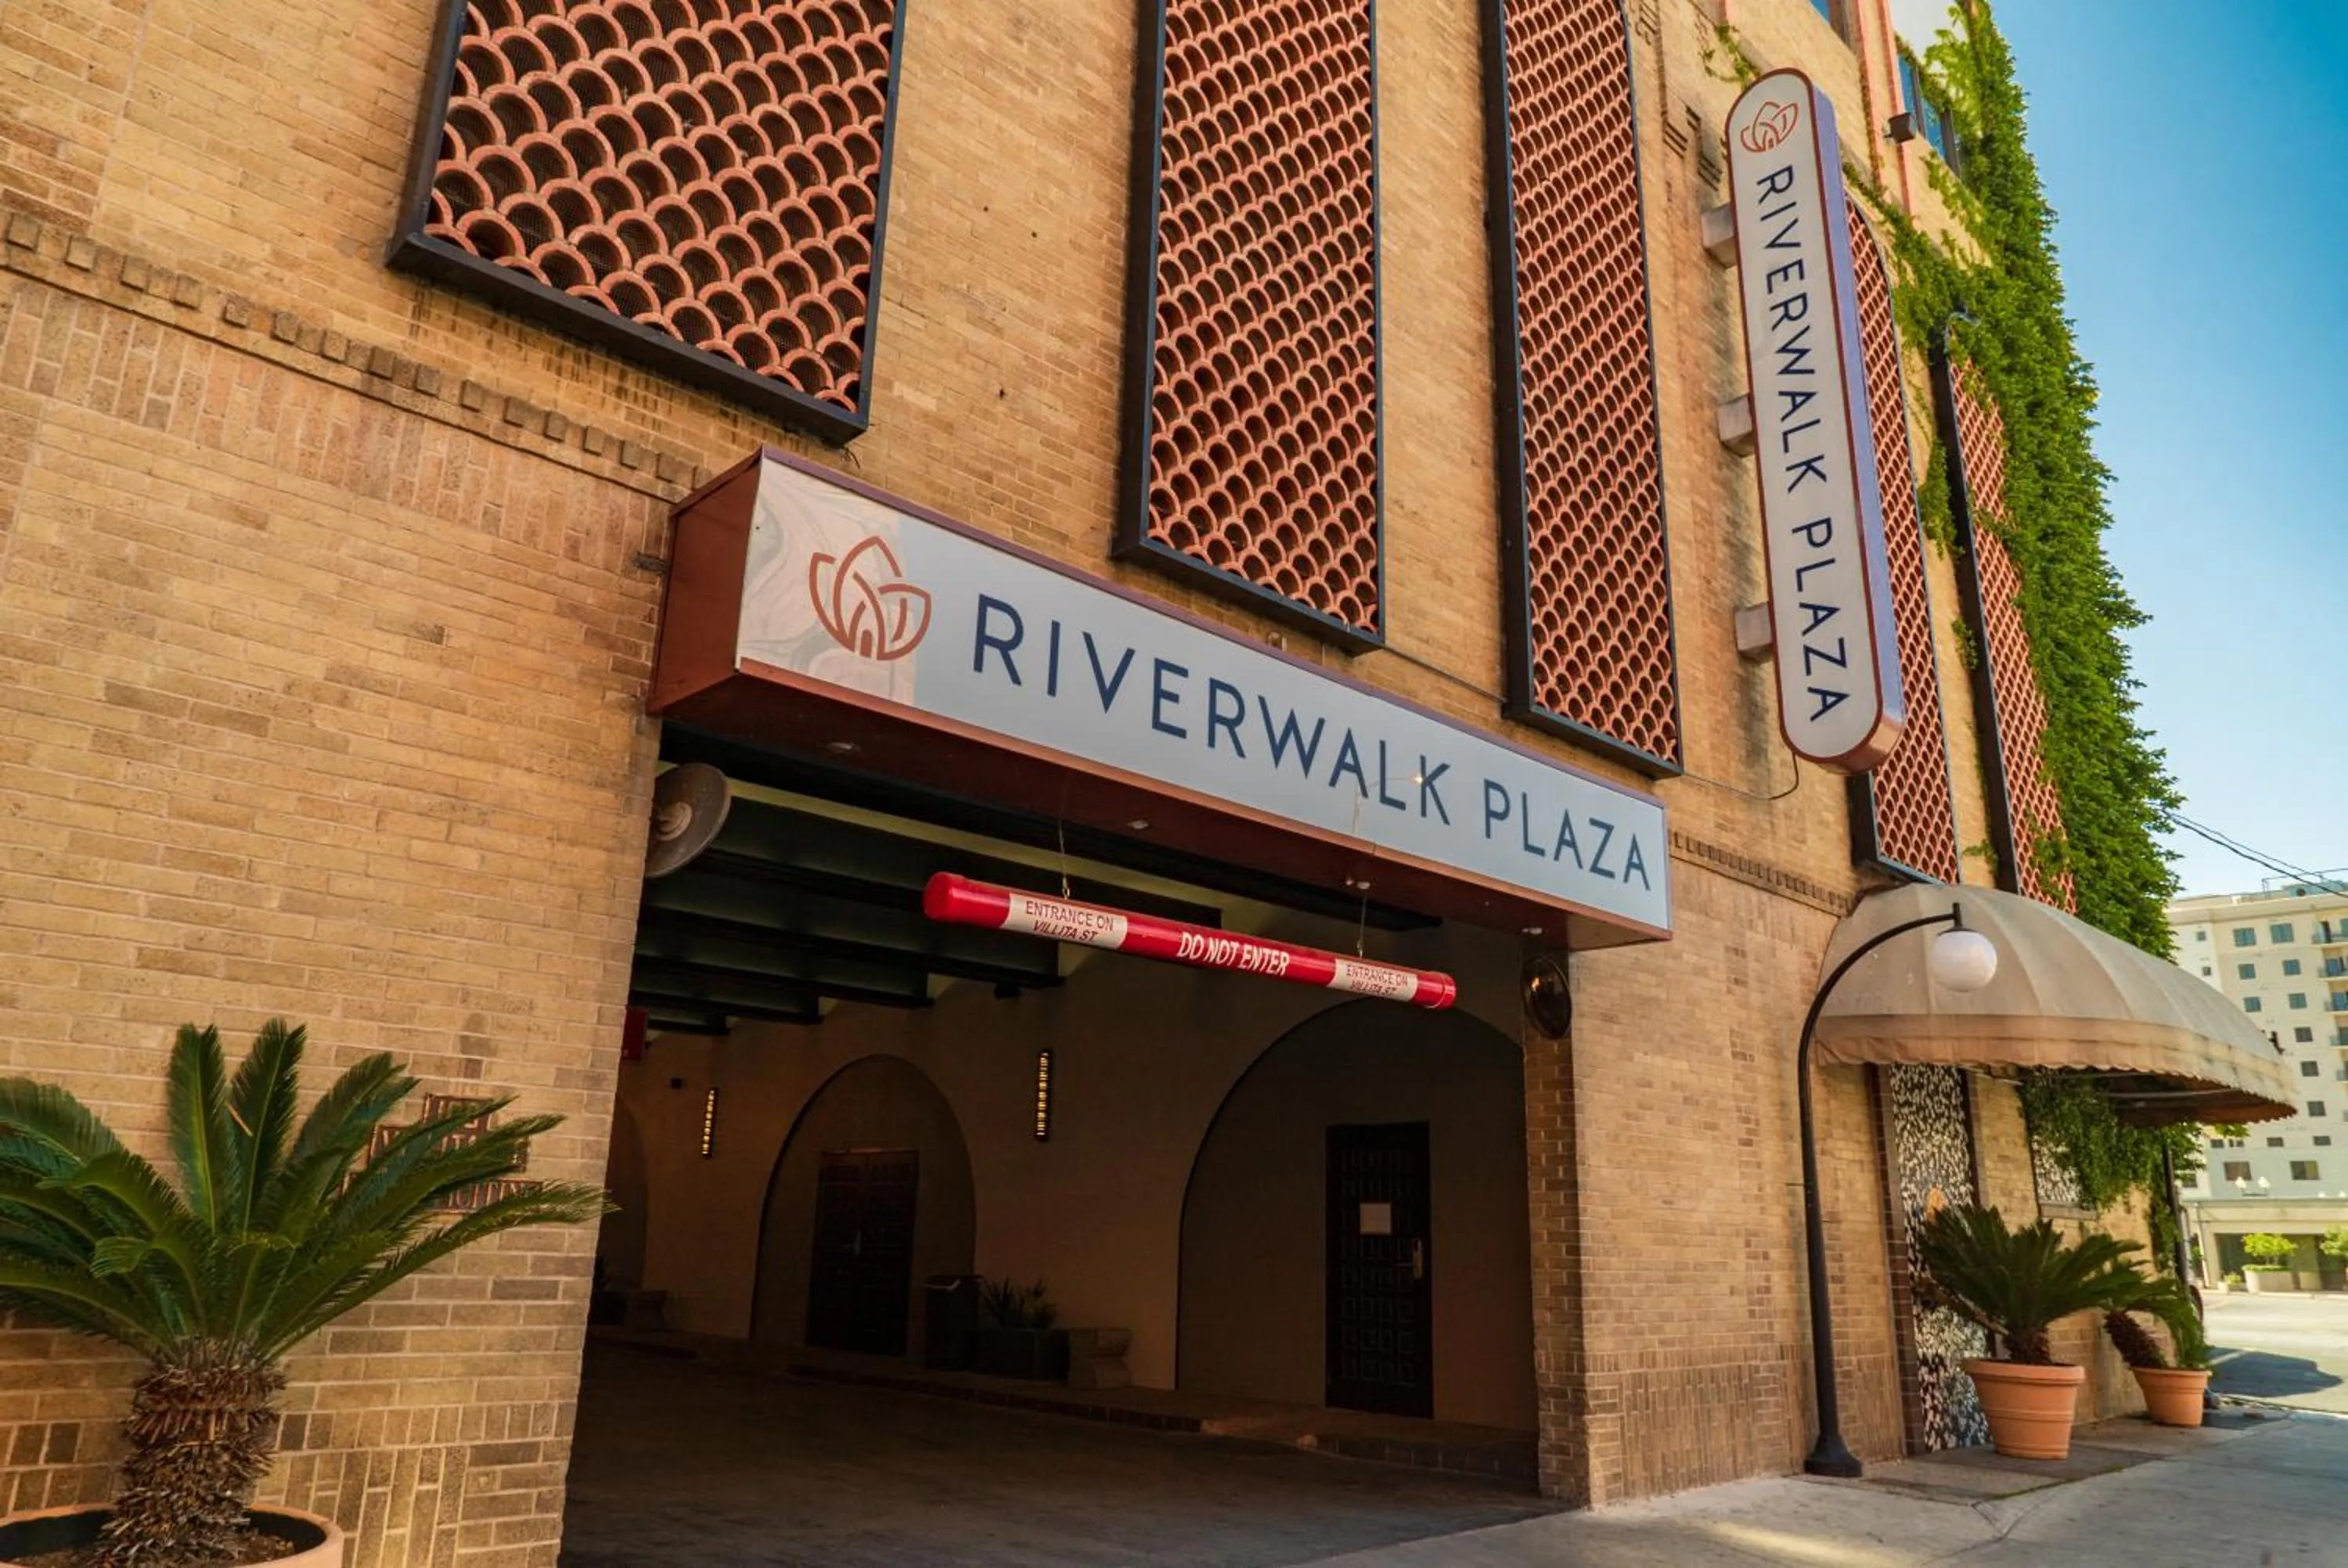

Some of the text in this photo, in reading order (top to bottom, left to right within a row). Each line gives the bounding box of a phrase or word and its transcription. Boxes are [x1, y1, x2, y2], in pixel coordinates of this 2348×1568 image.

[1756, 164, 1851, 722] RIVERWALK PLAZA
[973, 592, 1651, 892] RIVERWALK PLAZA
[1025, 901, 1115, 932] ENTRANCE ON
[1033, 919, 1099, 941] VILLITA ST
[1176, 930, 1290, 976] DO NOT ENTER
